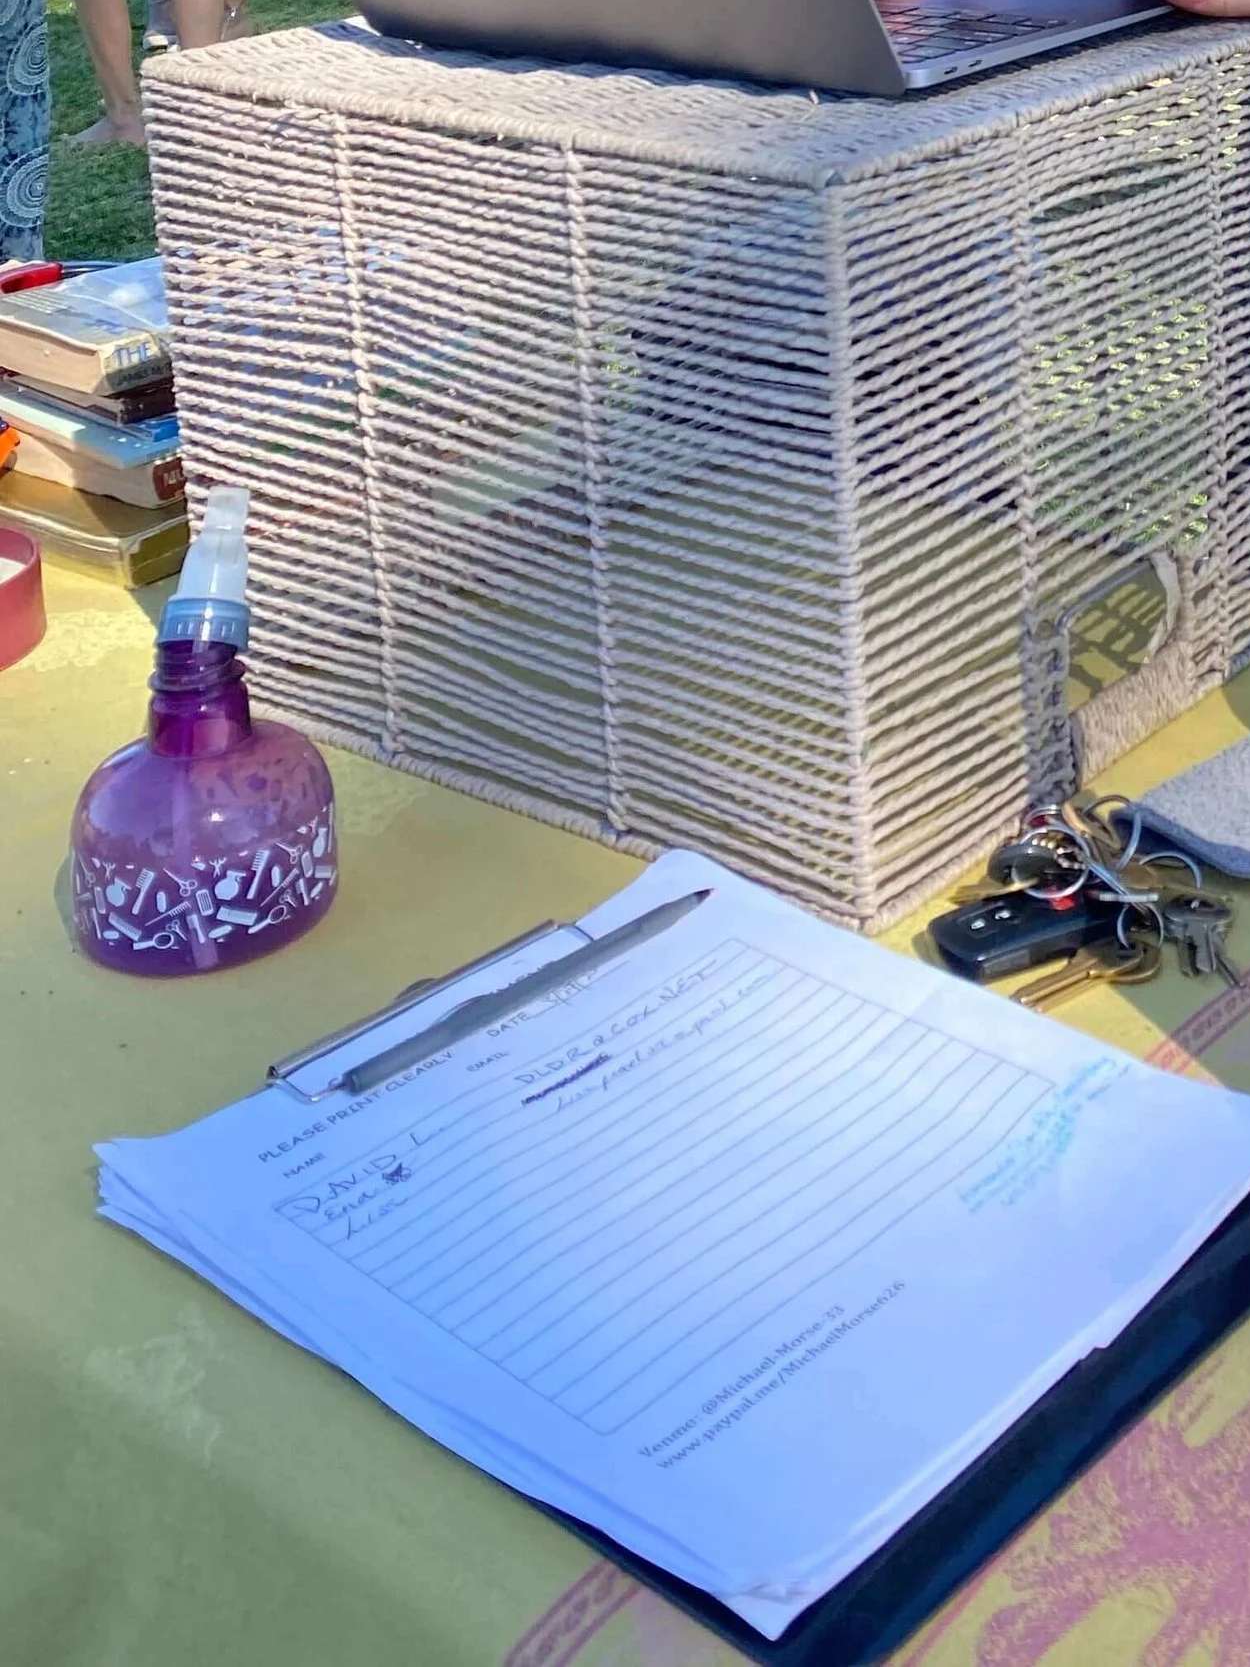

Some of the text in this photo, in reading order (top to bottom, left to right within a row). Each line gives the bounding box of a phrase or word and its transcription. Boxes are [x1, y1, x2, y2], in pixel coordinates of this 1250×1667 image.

[486, 1011, 531, 1038] DATE
[466, 1051, 509, 1073] EMAIL
[258, 1050, 454, 1163] PLEASE PRINT CLEARLY
[283, 1152, 327, 1179] NAME
[290, 1154, 397, 1214] DAVID
[638, 1413, 703, 1459] Venmo:
